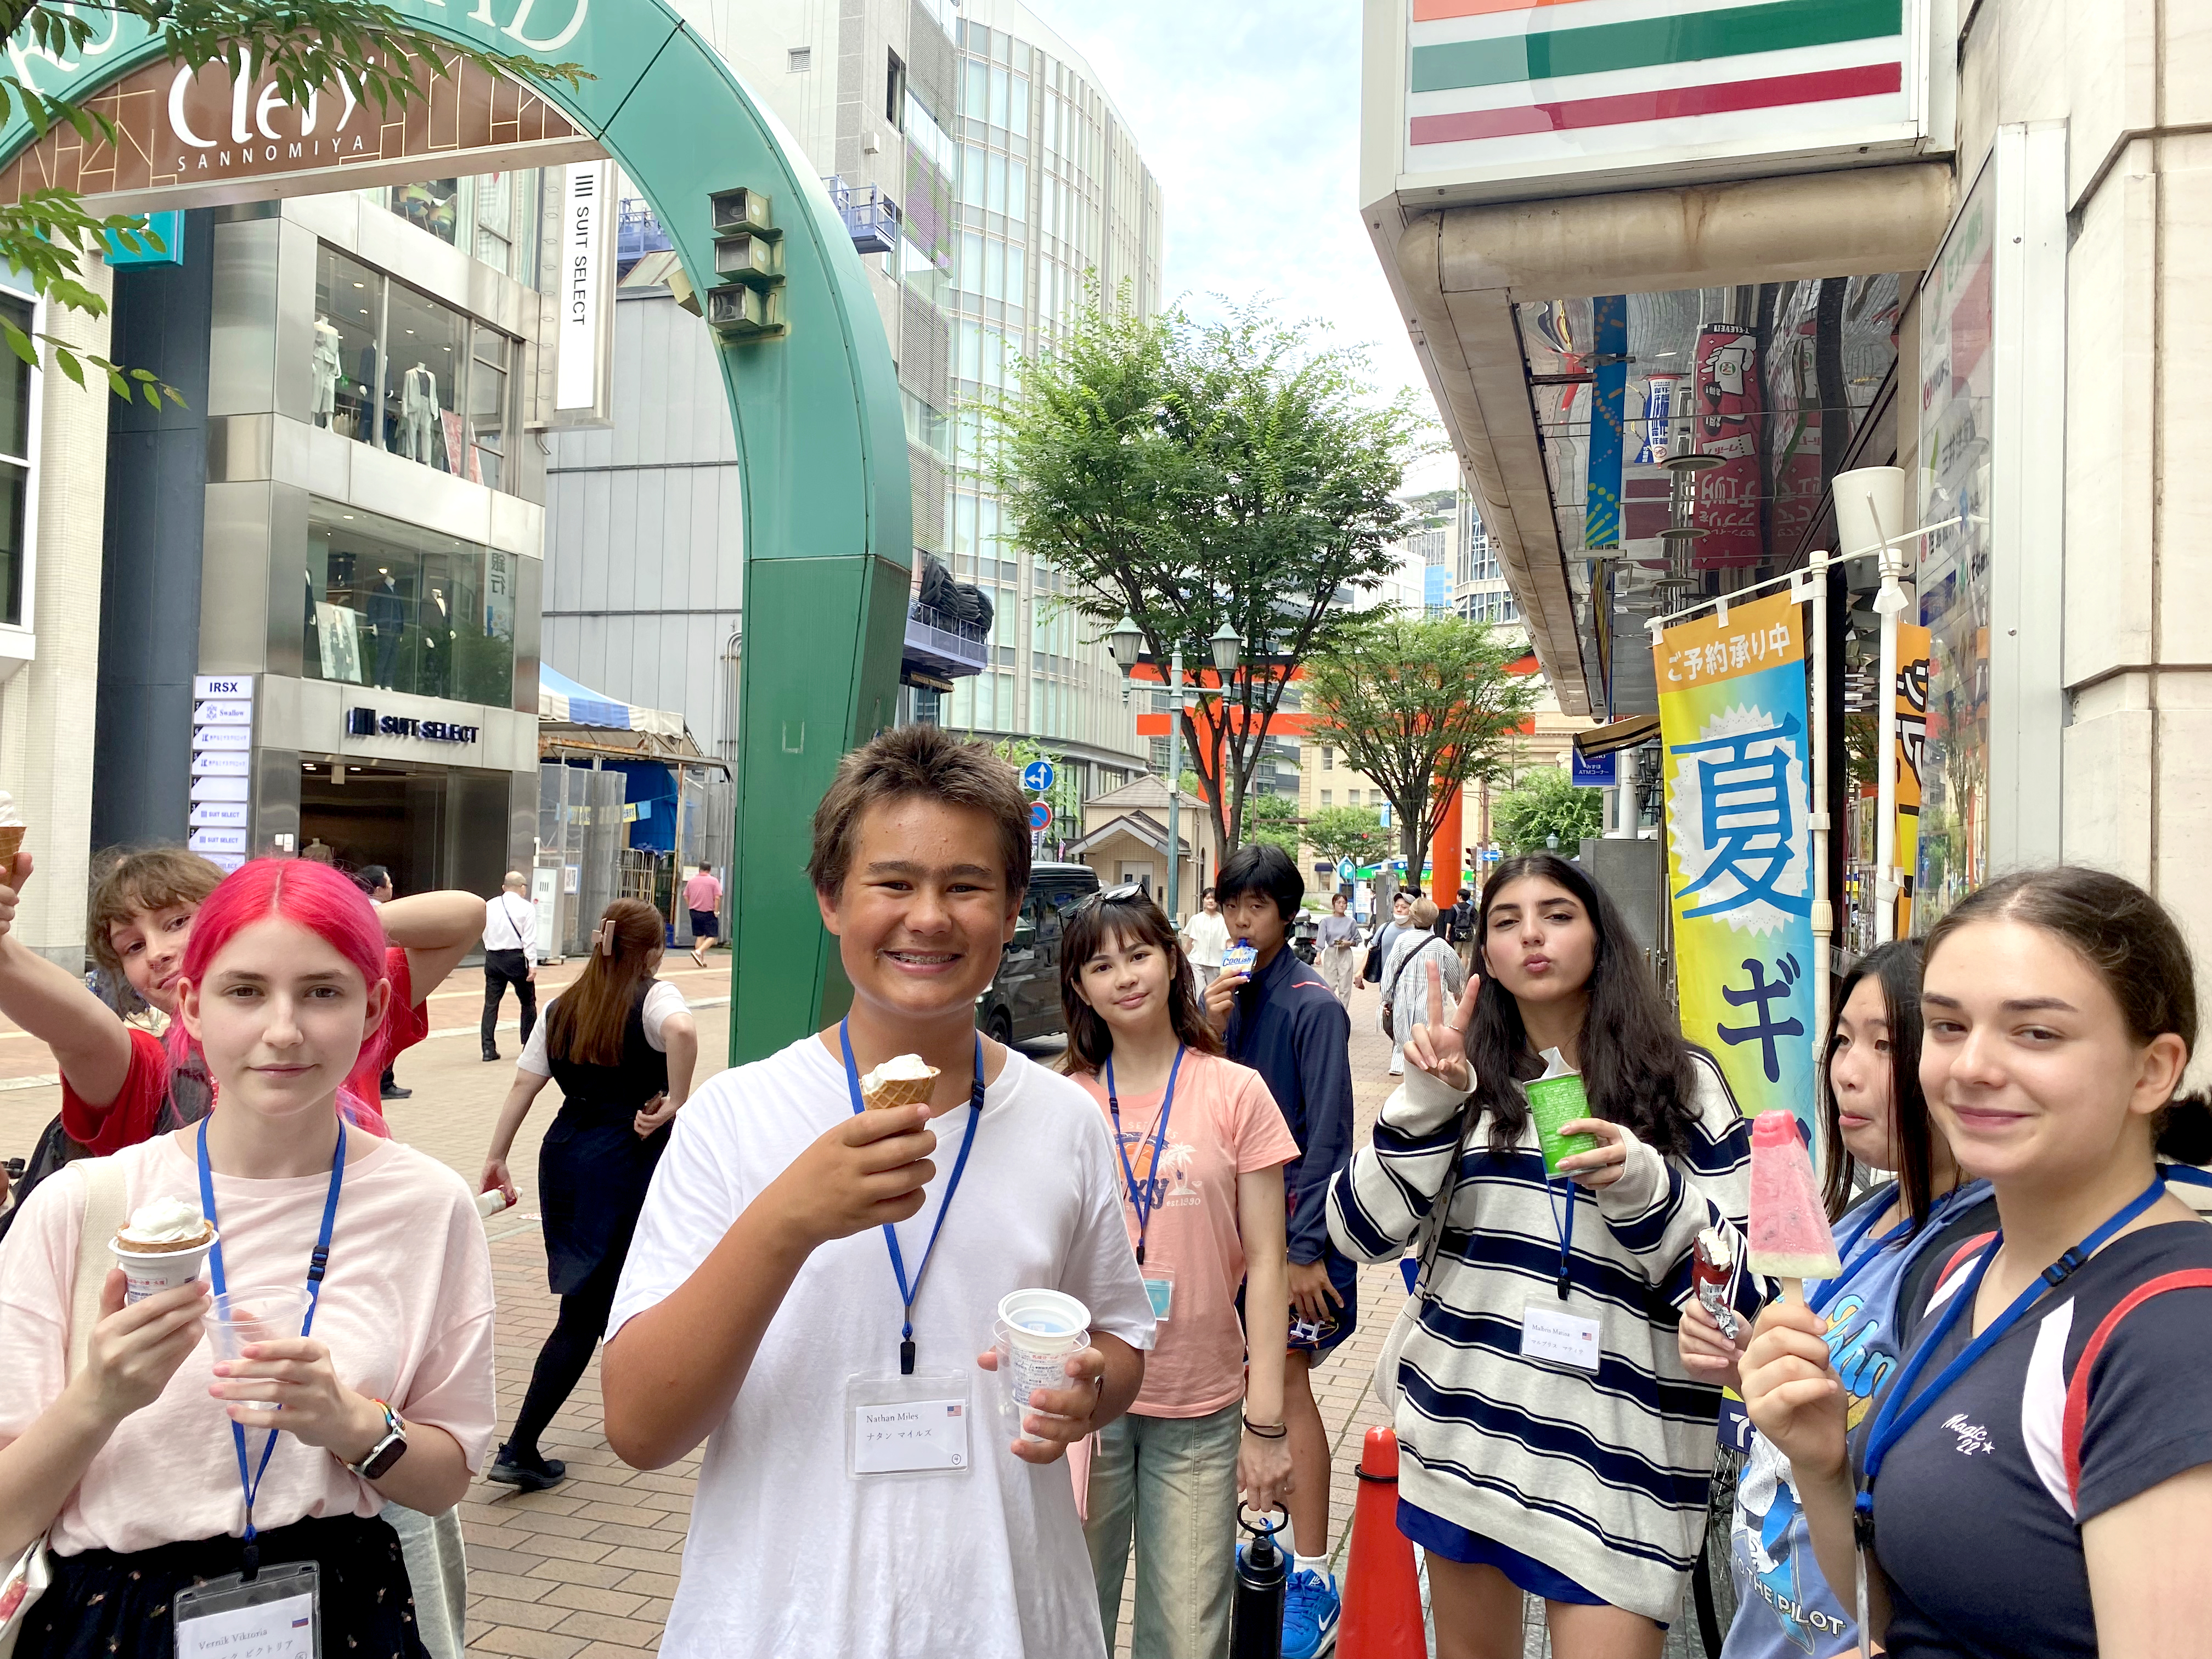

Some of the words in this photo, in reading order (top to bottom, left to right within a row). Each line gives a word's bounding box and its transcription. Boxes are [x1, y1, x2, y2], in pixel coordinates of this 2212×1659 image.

[178, 135, 363, 172] SANNOMIYA
[575, 206, 590, 249] SUIT
[572, 256, 587, 326] SELECT
[1668, 622, 1791, 682] ご予約承り中
[209, 682, 238, 693] IRSX
[379, 715, 420, 736] SUIT
[420, 721, 479, 743] SELECT
[1344, 865, 1352, 876] P
[866, 1414, 895, 1423] Nathan
[898, 1412, 919, 1421] Miles
[1941, 1413, 1988, 1441] Magic
[866, 1432, 892, 1441] ナタン
[1956, 1439, 1980, 1456] 22
[1746, 1565, 1774, 1605] THE
[1777, 1592, 1846, 1638] PILOT
[246, 1639, 294, 1658] ビクトリア
